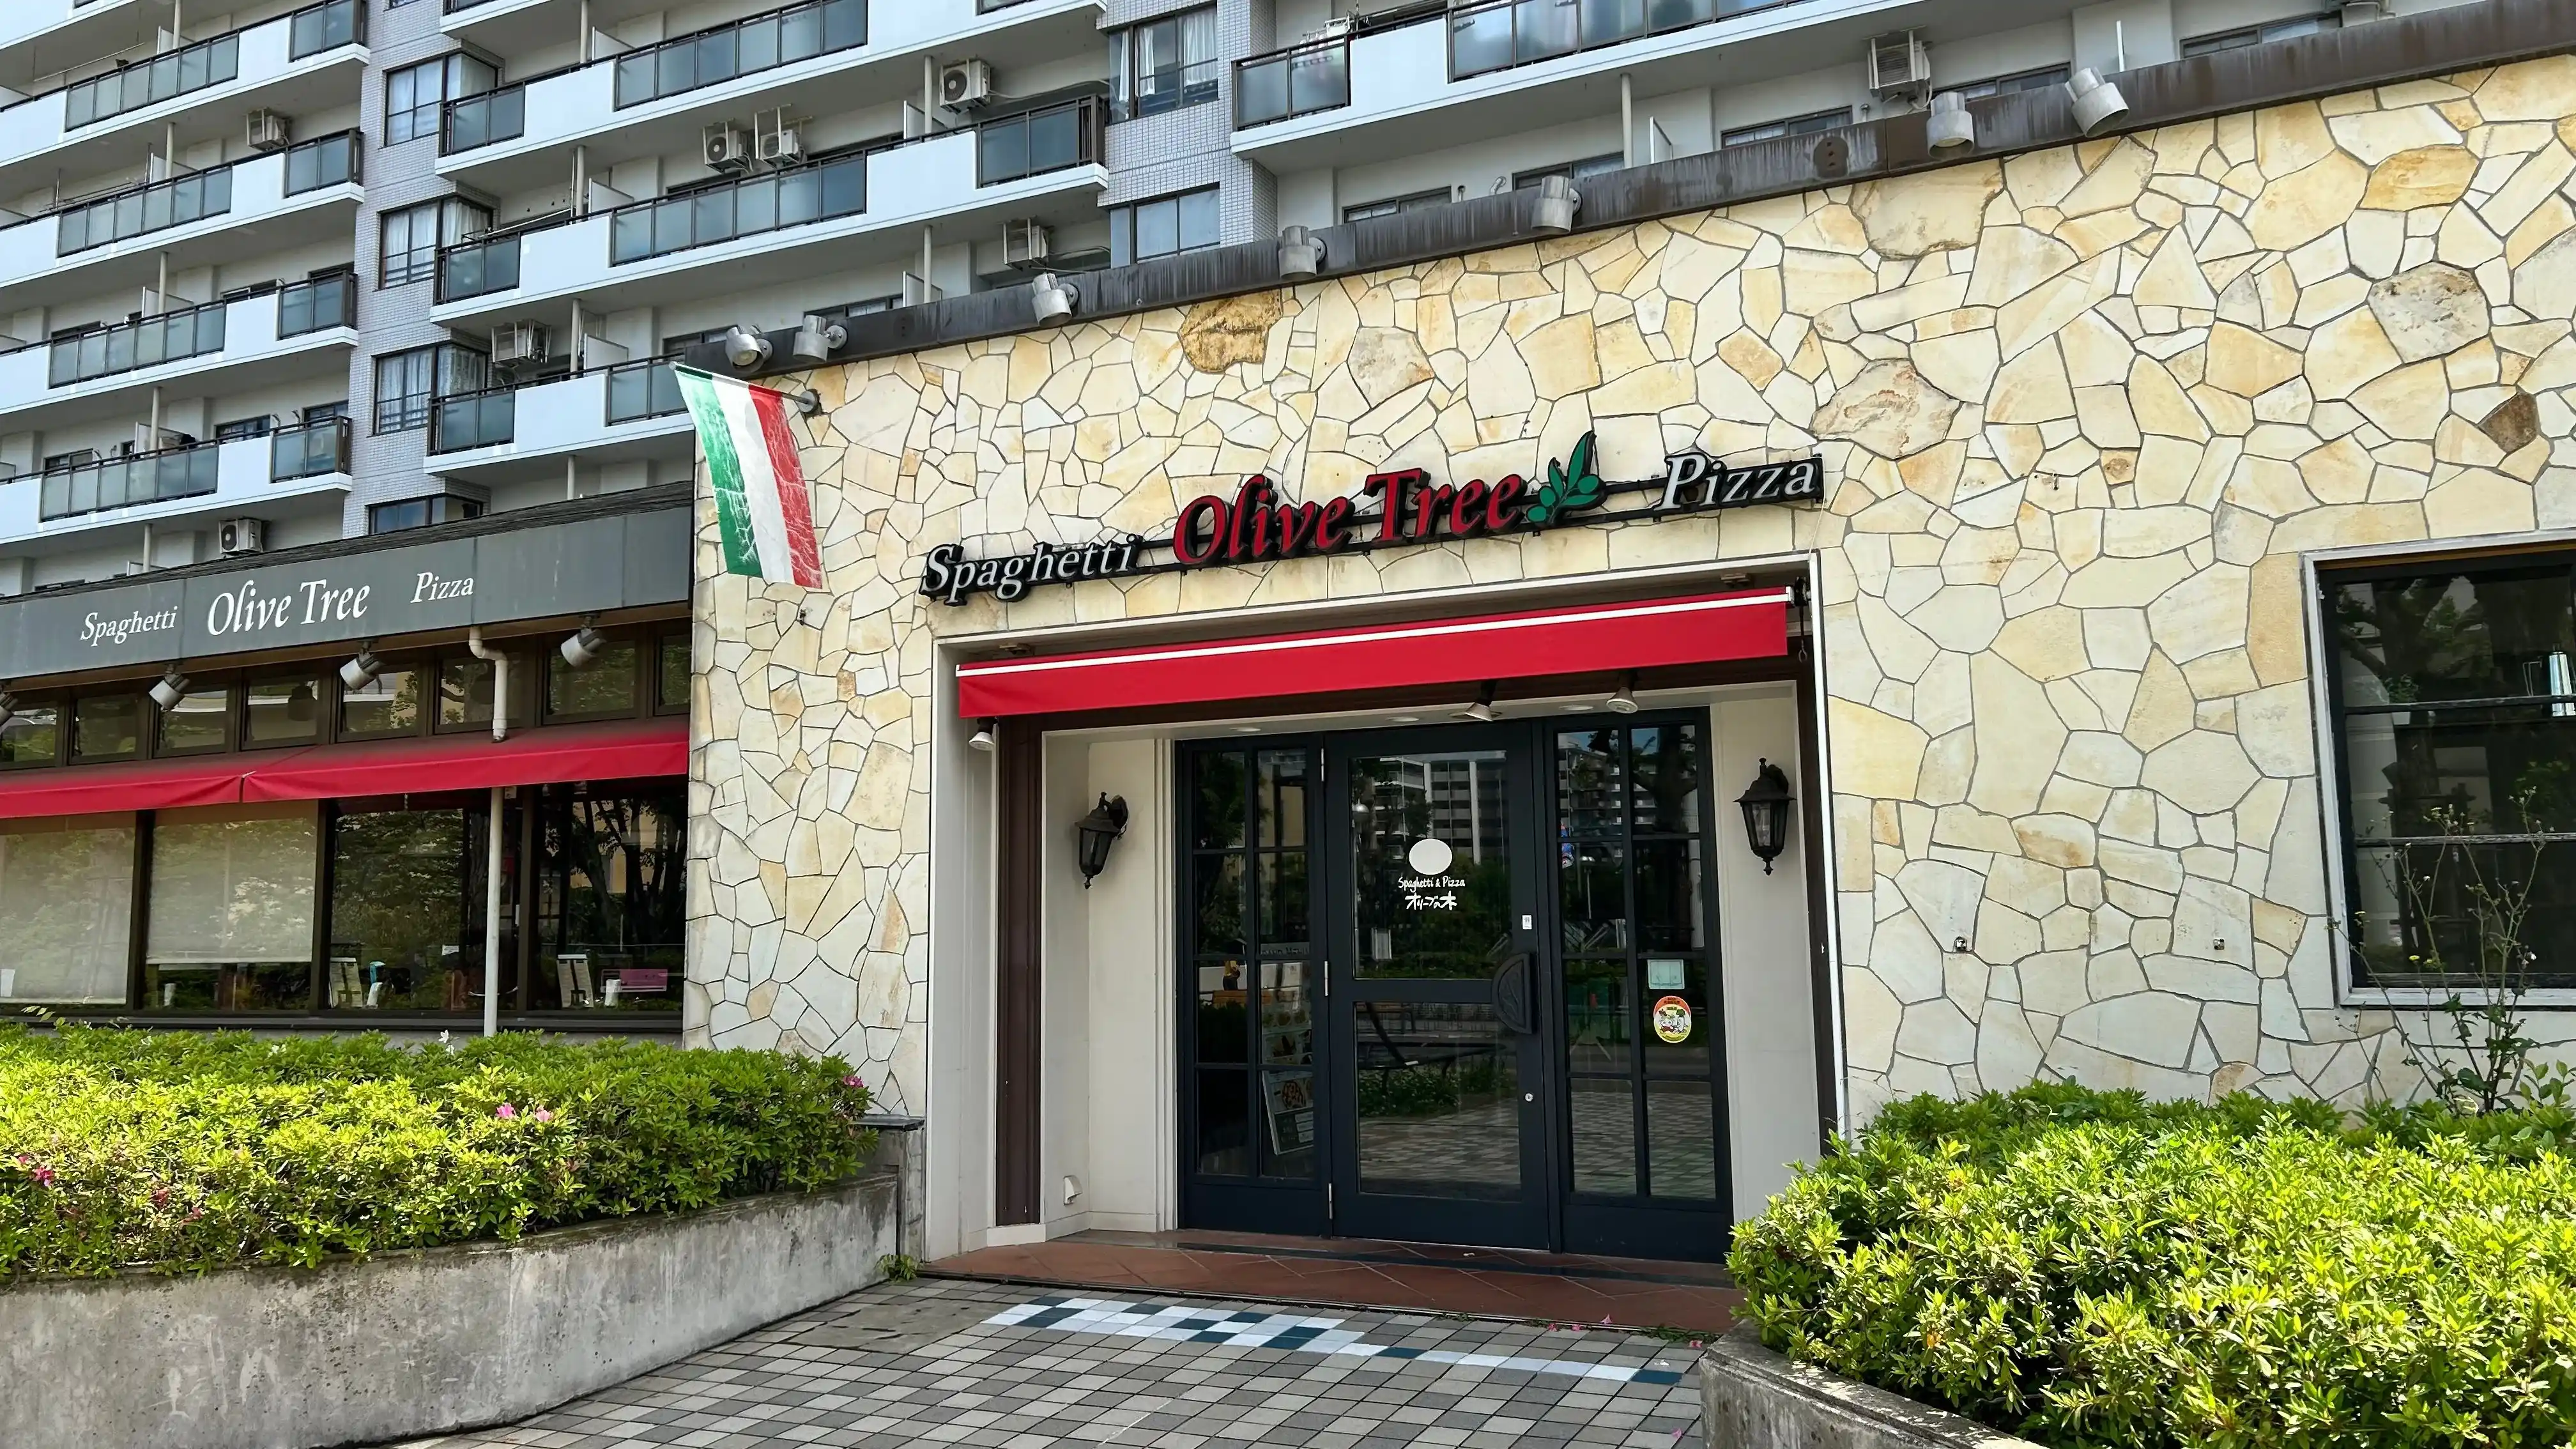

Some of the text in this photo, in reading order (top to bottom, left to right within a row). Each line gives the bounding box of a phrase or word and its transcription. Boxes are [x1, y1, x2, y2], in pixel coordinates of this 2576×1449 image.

[920, 452, 1823, 604] Spaghetti Olive Tree Pizza
[80, 572, 475, 647] Spaghetti Olive Tree Pizza
[1398, 875, 1466, 893] Spaghetti & Pizza
[1405, 890, 1457, 910] オリーブの木
